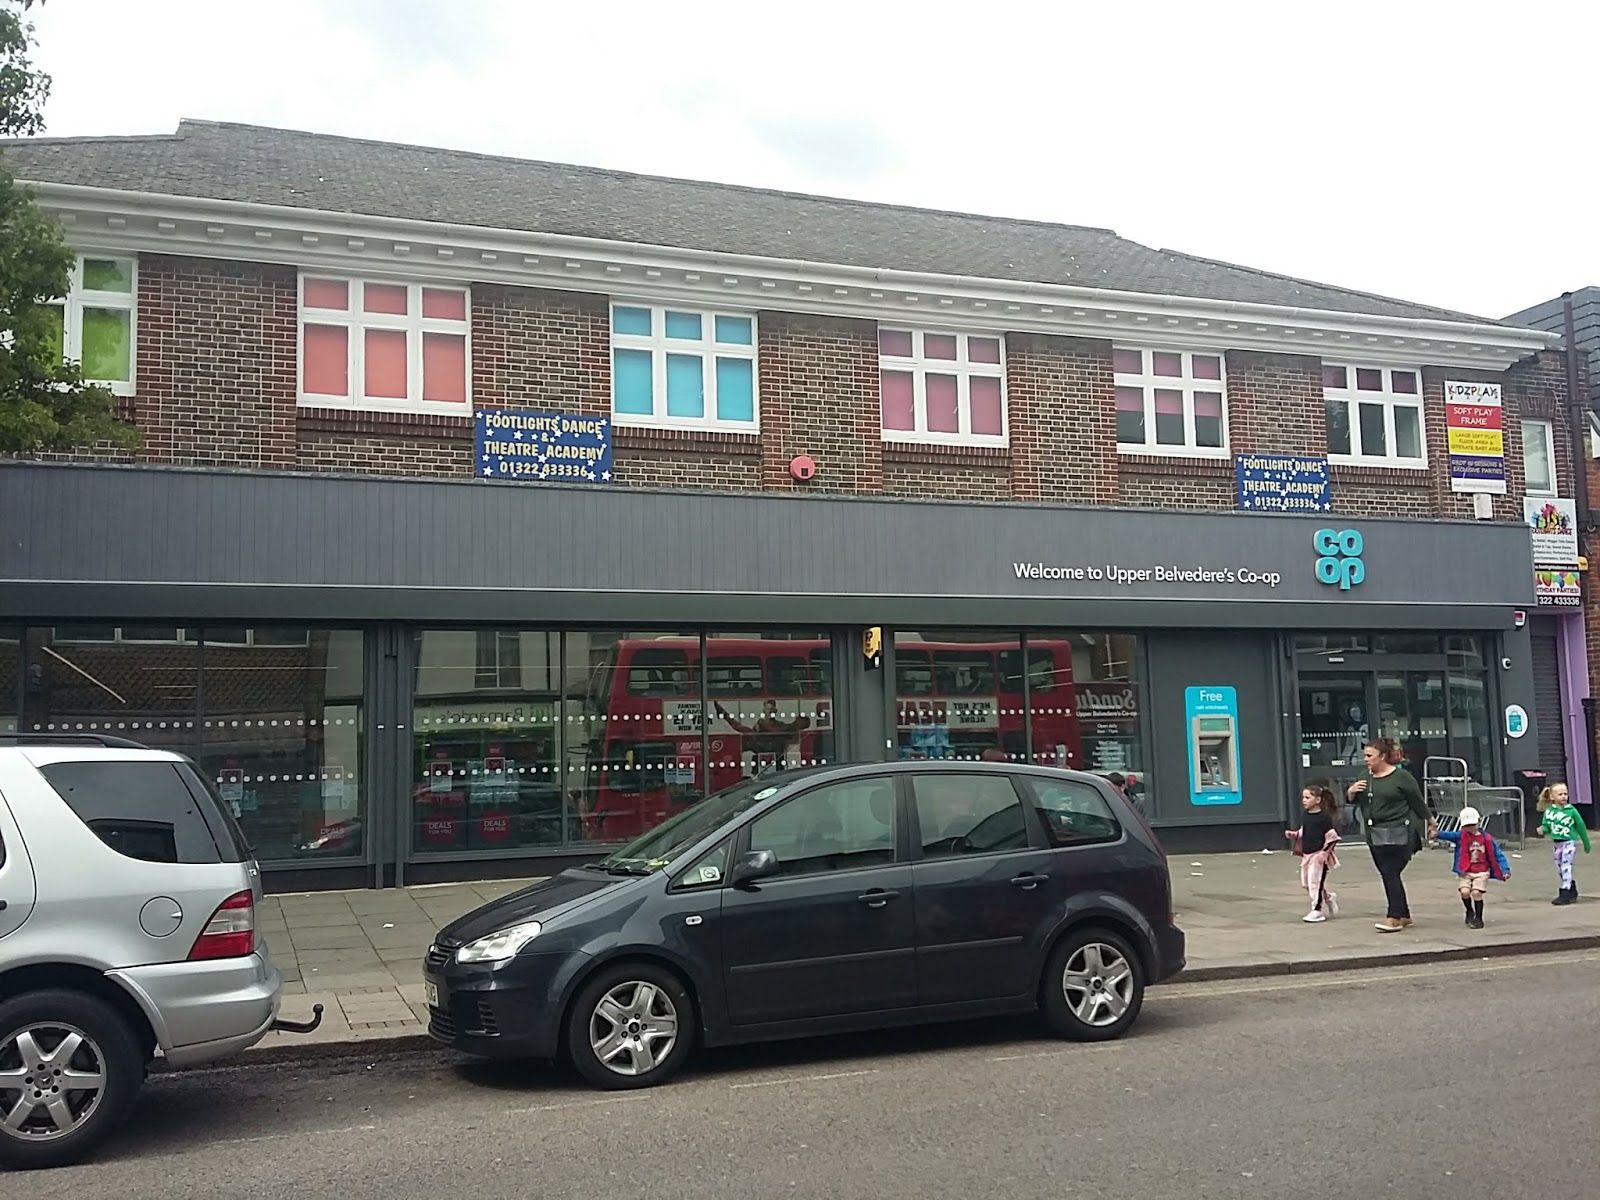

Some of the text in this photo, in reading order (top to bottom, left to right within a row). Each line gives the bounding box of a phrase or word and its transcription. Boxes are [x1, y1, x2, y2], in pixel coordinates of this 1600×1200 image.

[1453, 407, 1493, 416] SOFT PLAY
[485, 414, 602, 434] FOOTLIGHTS DANCE
[1461, 417, 1487, 425] FRAME
[541, 432, 549, 442] &
[484, 441, 604, 460] THEATRE ACADEMY
[500, 461, 587, 477] 01322 433336
[1243, 458, 1323, 472] FOOTLIGHTS DANCE
[1282, 472, 1287, 480] &
[1243, 480, 1325, 494] THEATRE ACADEMY
[1255, 496, 1315, 508] 01322 433336
[1013, 562, 1280, 587] Welcome to Upper Belvedere's Co-op
[1539, 597, 1580, 605] 322 433336
[1200, 690, 1223, 702] Free
